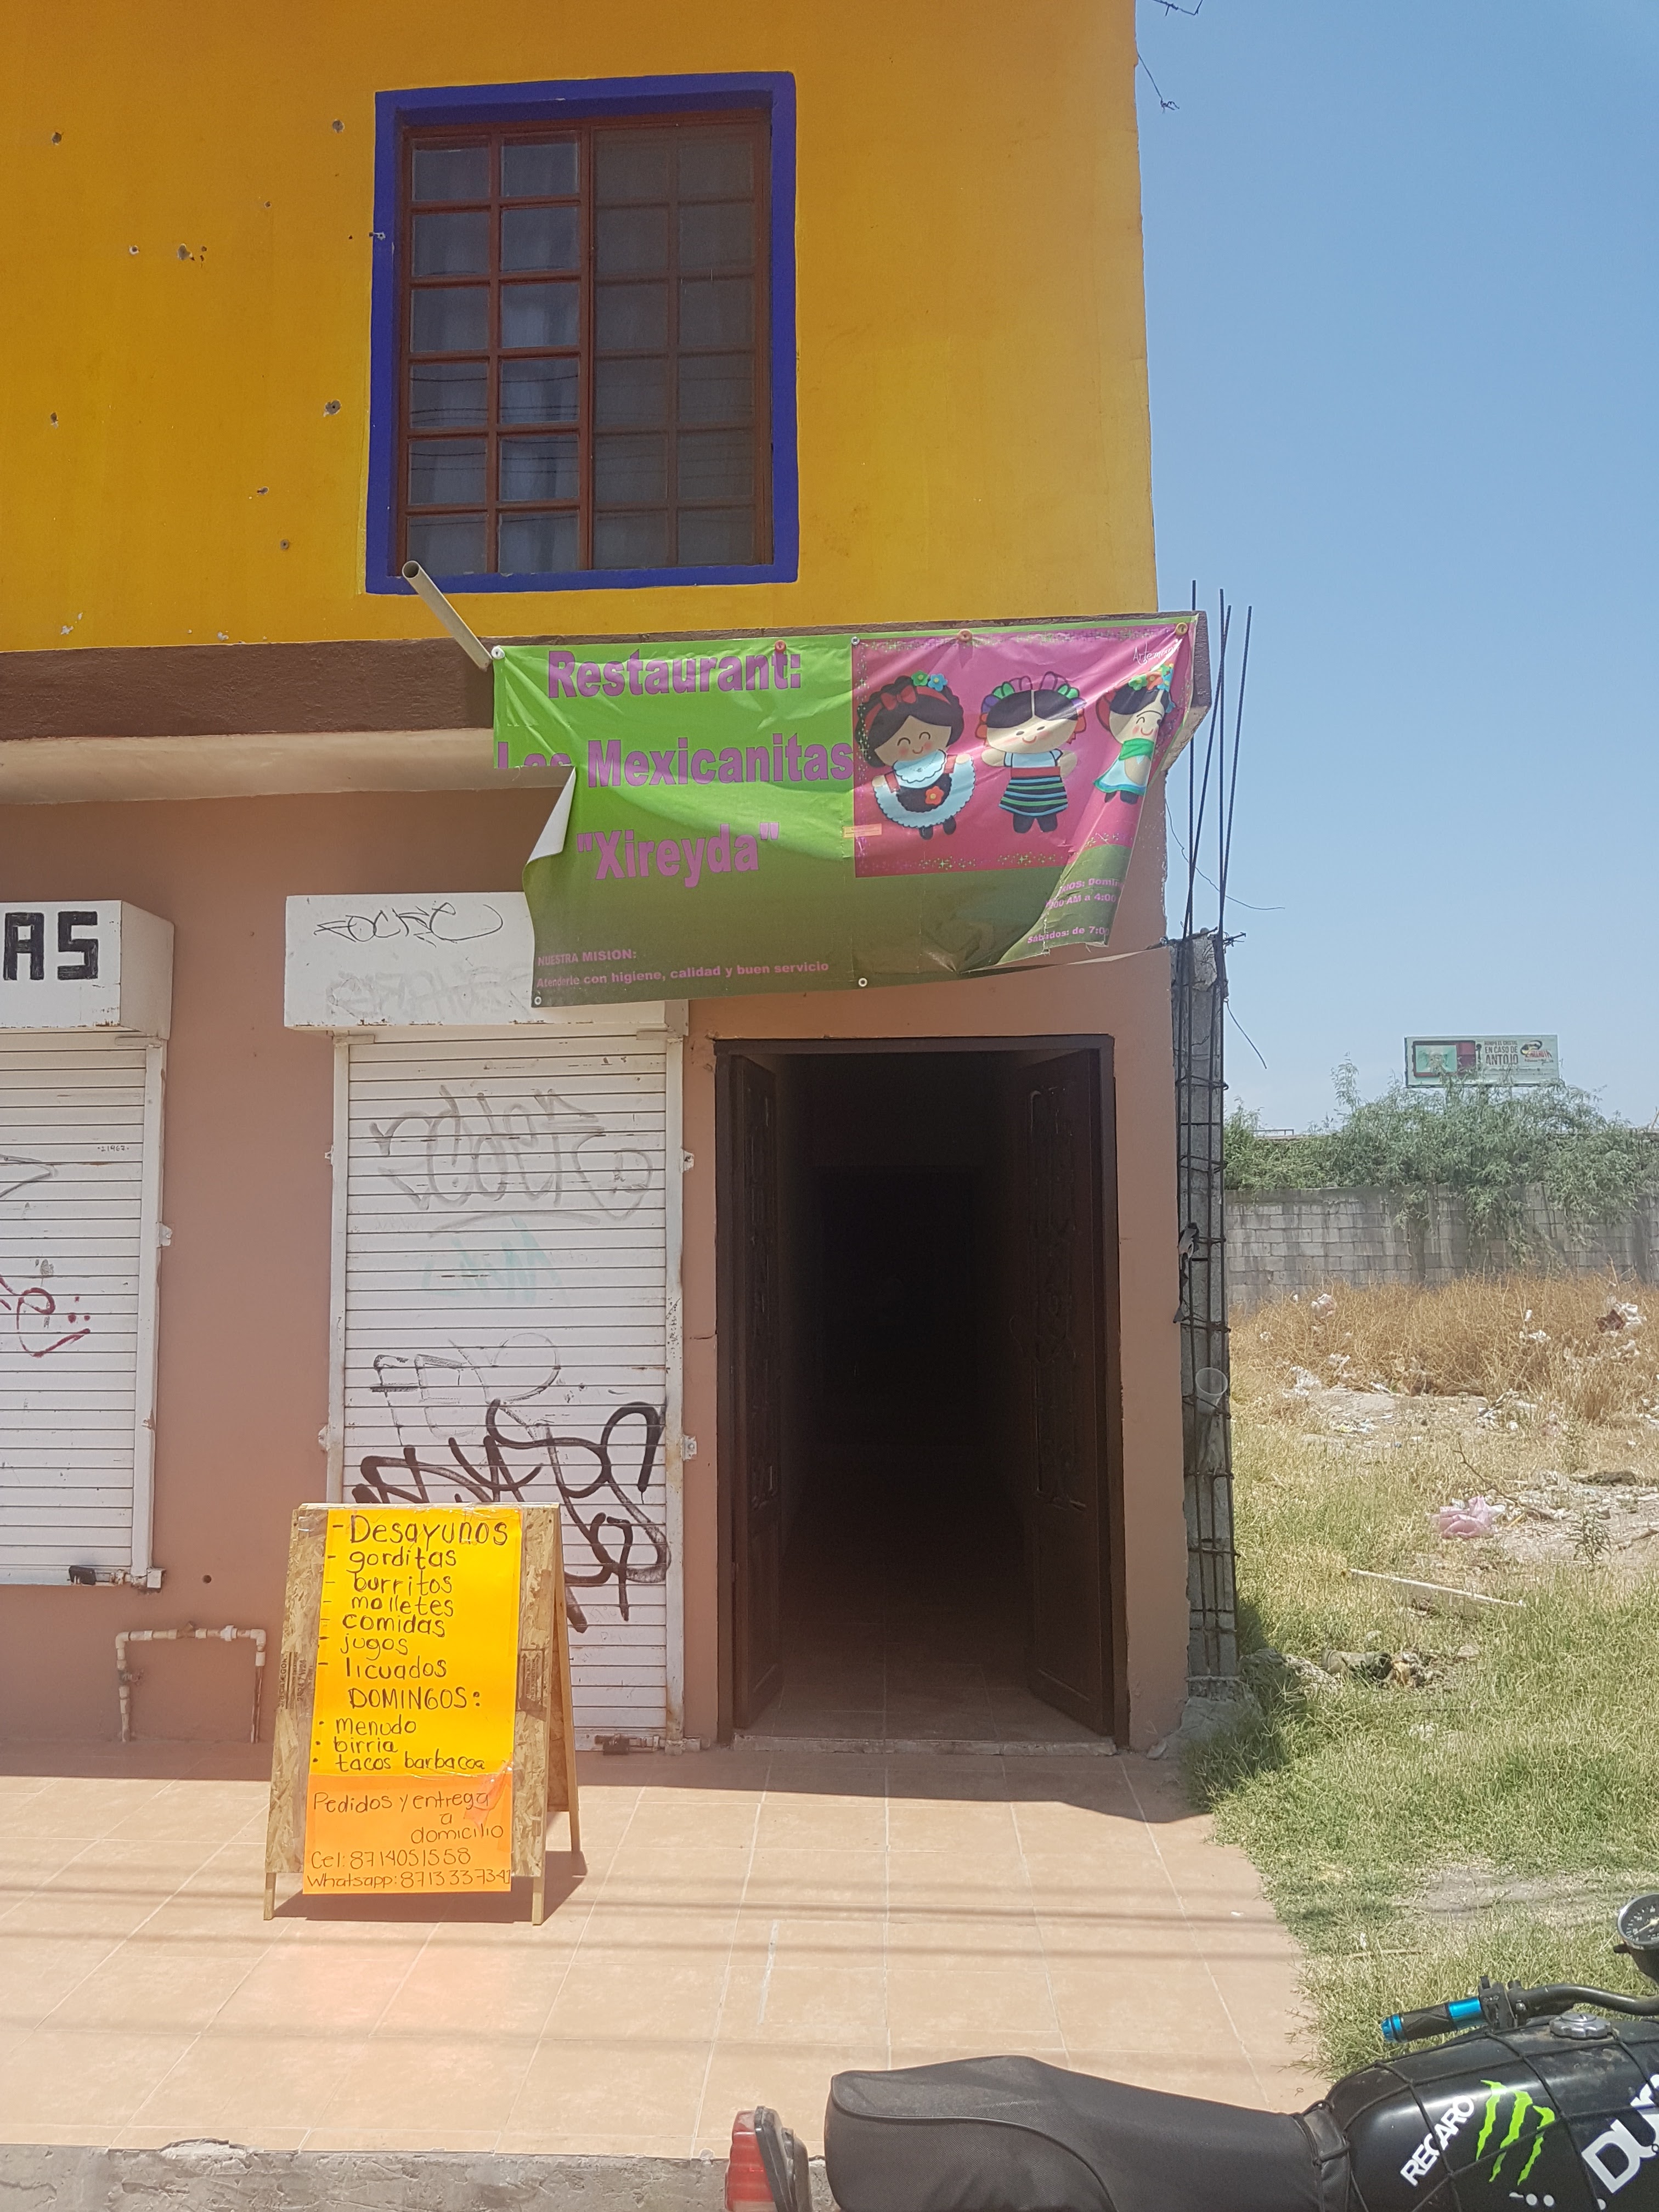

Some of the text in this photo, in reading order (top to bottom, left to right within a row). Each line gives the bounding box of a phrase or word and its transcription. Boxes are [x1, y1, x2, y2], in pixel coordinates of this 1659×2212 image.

[549, 649, 800, 697] Restaurant:
[589, 733, 854, 787] Mexicanitas
[577, 822, 778, 888] "Xireyda"
[1065, 895, 1082, 905] AM
[1072, 926, 1085, 935] de
[3, 911, 99, 981] AS
[538, 949, 636, 966] NUESTRA MISION:
[537, 961, 829, 988] Atenderle con higiene, calidad y buen servicio
[1486, 1054, 1519, 1065] ANTOJO
[350, 1515, 508, 1550] Desayunos
[347, 1546, 456, 1572] gorditas
[353, 1570, 452, 1594] burritos
[348, 1595, 453, 1617] molletes
[342, 1613, 446, 1637] comidas
[341, 1634, 408, 1660] jugos
[347, 1656, 447, 1679] licuados
[348, 1686, 479, 1709] DOMINGOS:
[336, 1714, 416, 1735] menudo
[334, 1737, 398, 1753] birria
[336, 1748, 484, 1772] tacos barbacoa
[314, 1791, 488, 1813] Pedidos y entrega
[439, 1813, 453, 1825] a
[411, 1822, 503, 1843] domicilio
[312, 1852, 345, 1868] Cel:
[308, 1873, 397, 1888] Whatsapp:
[1399, 2095, 1475, 2187] RECARO
